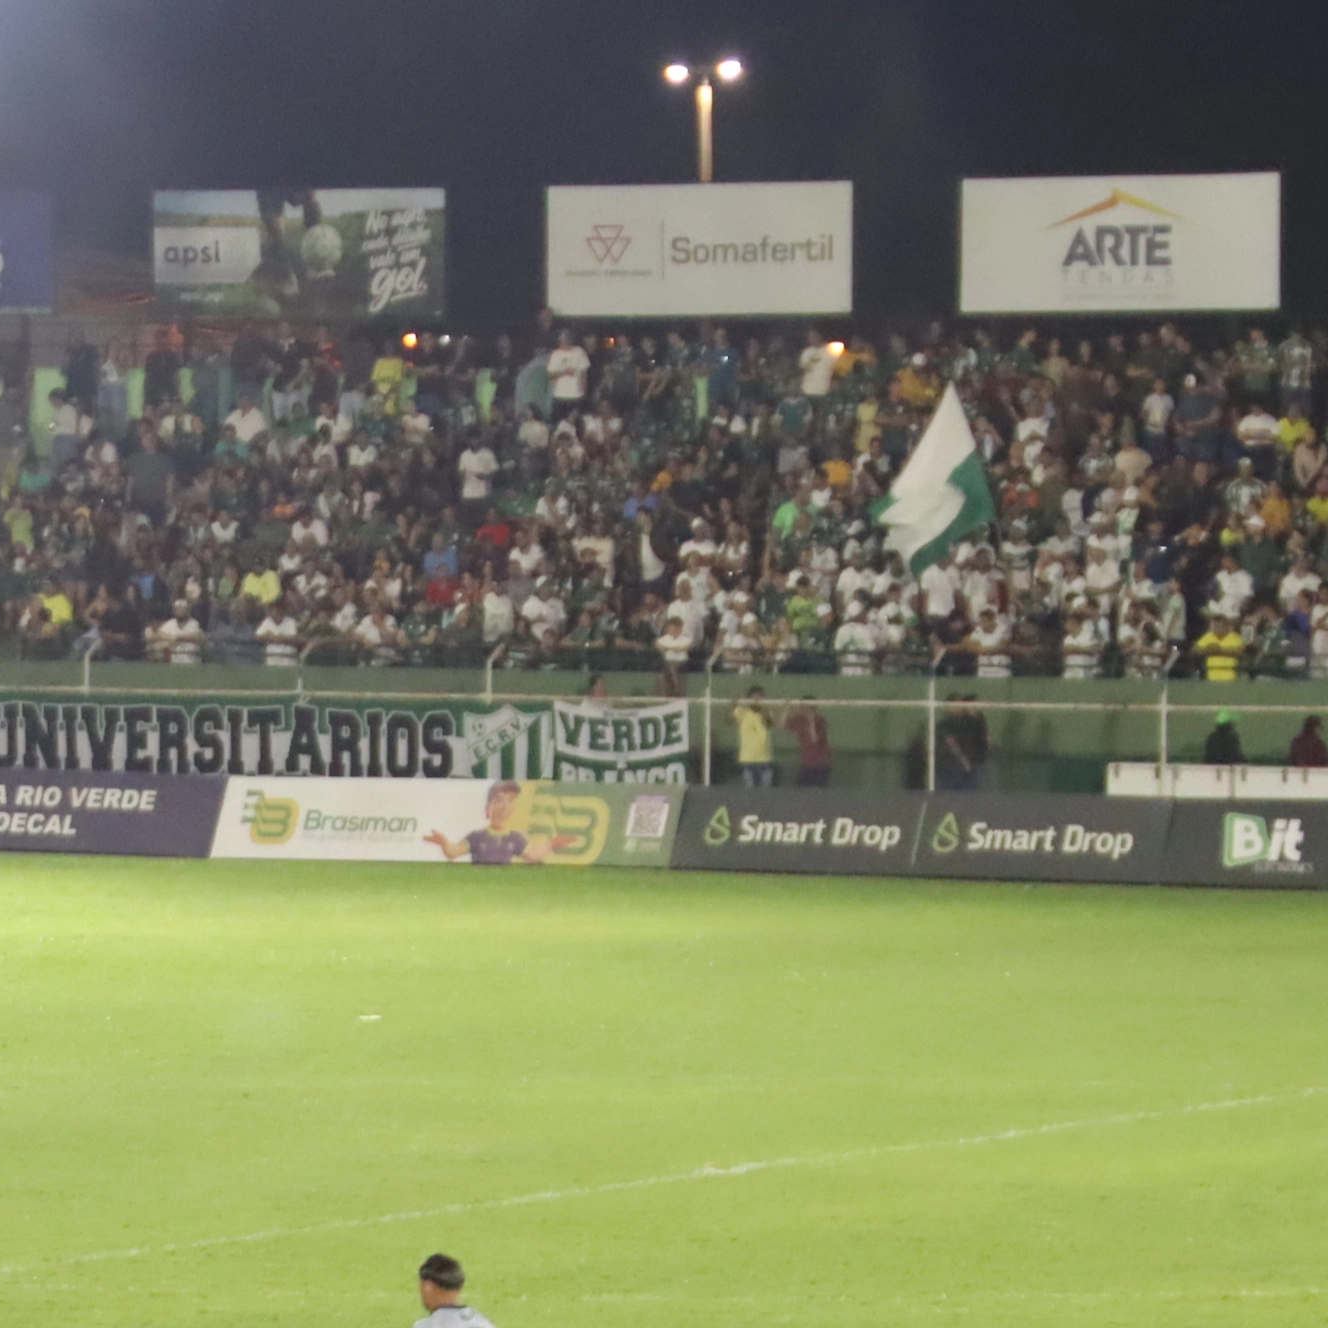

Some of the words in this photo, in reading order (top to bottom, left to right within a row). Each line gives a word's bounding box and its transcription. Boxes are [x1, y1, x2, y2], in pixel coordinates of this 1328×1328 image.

[163, 239, 222, 266] apsi
[671, 234, 833, 264] Somafertil
[1062, 223, 1172, 268] ARTE
[558, 709, 684, 752] VERDE
[14, 785, 63, 807] RIO
[71, 786, 157, 811] VERDE
[303, 808, 418, 833] Brasiman
[738, 815, 827, 845] Smart
[832, 817, 902, 851] Drop
[967, 822, 1057, 851] Smart
[1061, 824, 1134, 859] Drop
[1231, 817, 1305, 862] Bit
